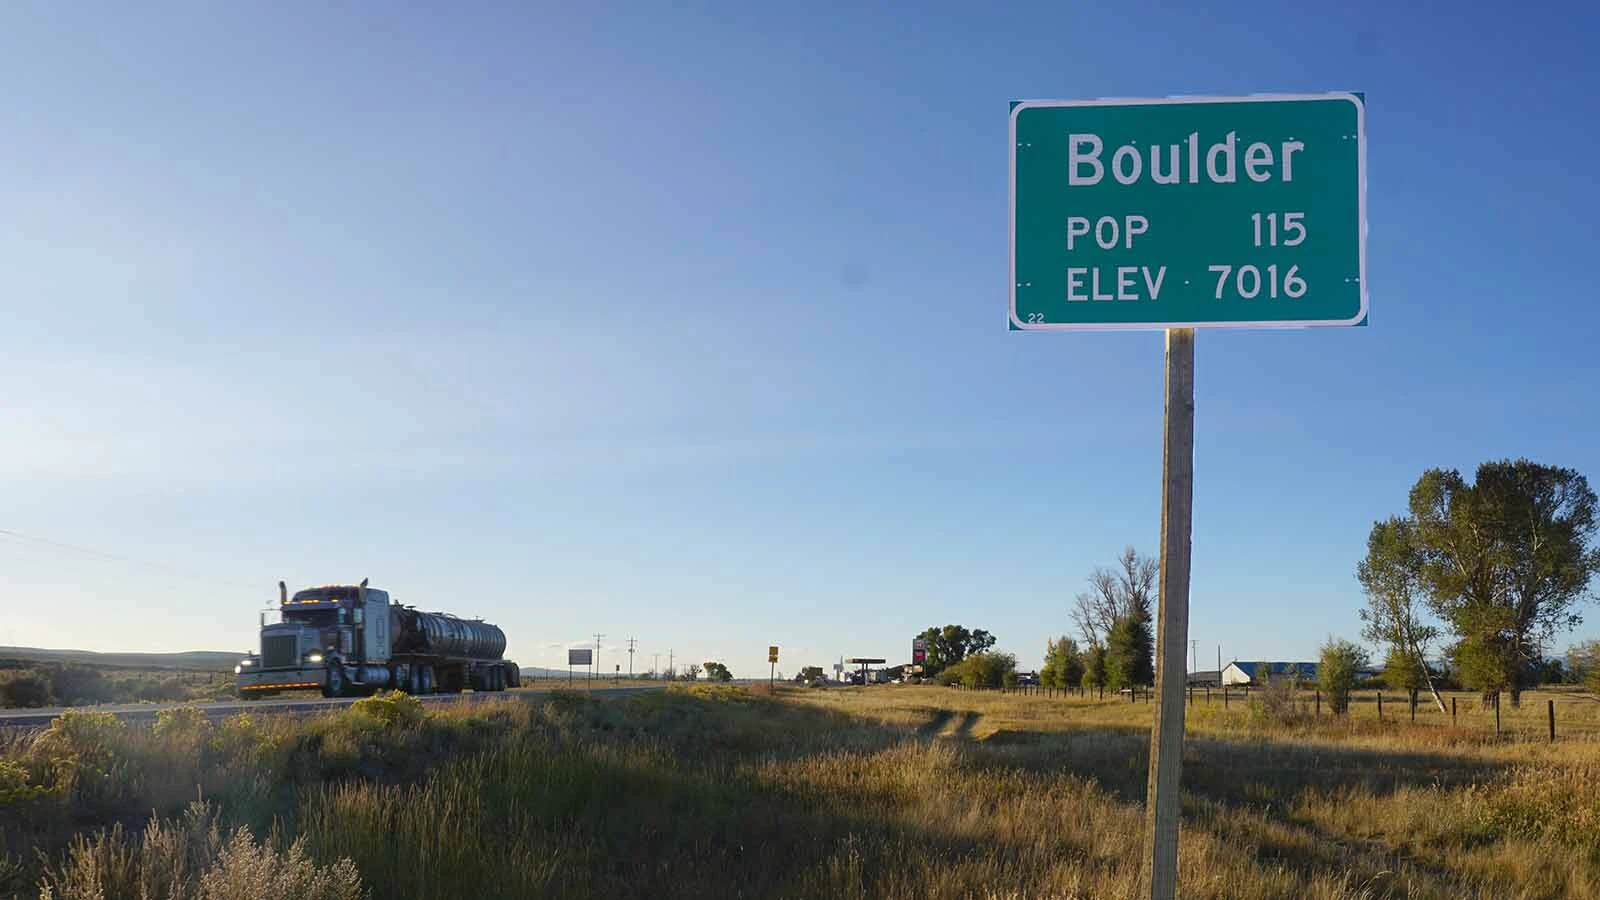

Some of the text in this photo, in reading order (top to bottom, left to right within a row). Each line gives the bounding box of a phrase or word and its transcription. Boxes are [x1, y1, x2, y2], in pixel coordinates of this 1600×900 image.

[1067, 131, 1305, 186] Boulder
[1067, 212, 1307, 251] POP 115
[1067, 264, 1307, 302] ELEV 7016
[1028, 312, 1045, 324] 22
